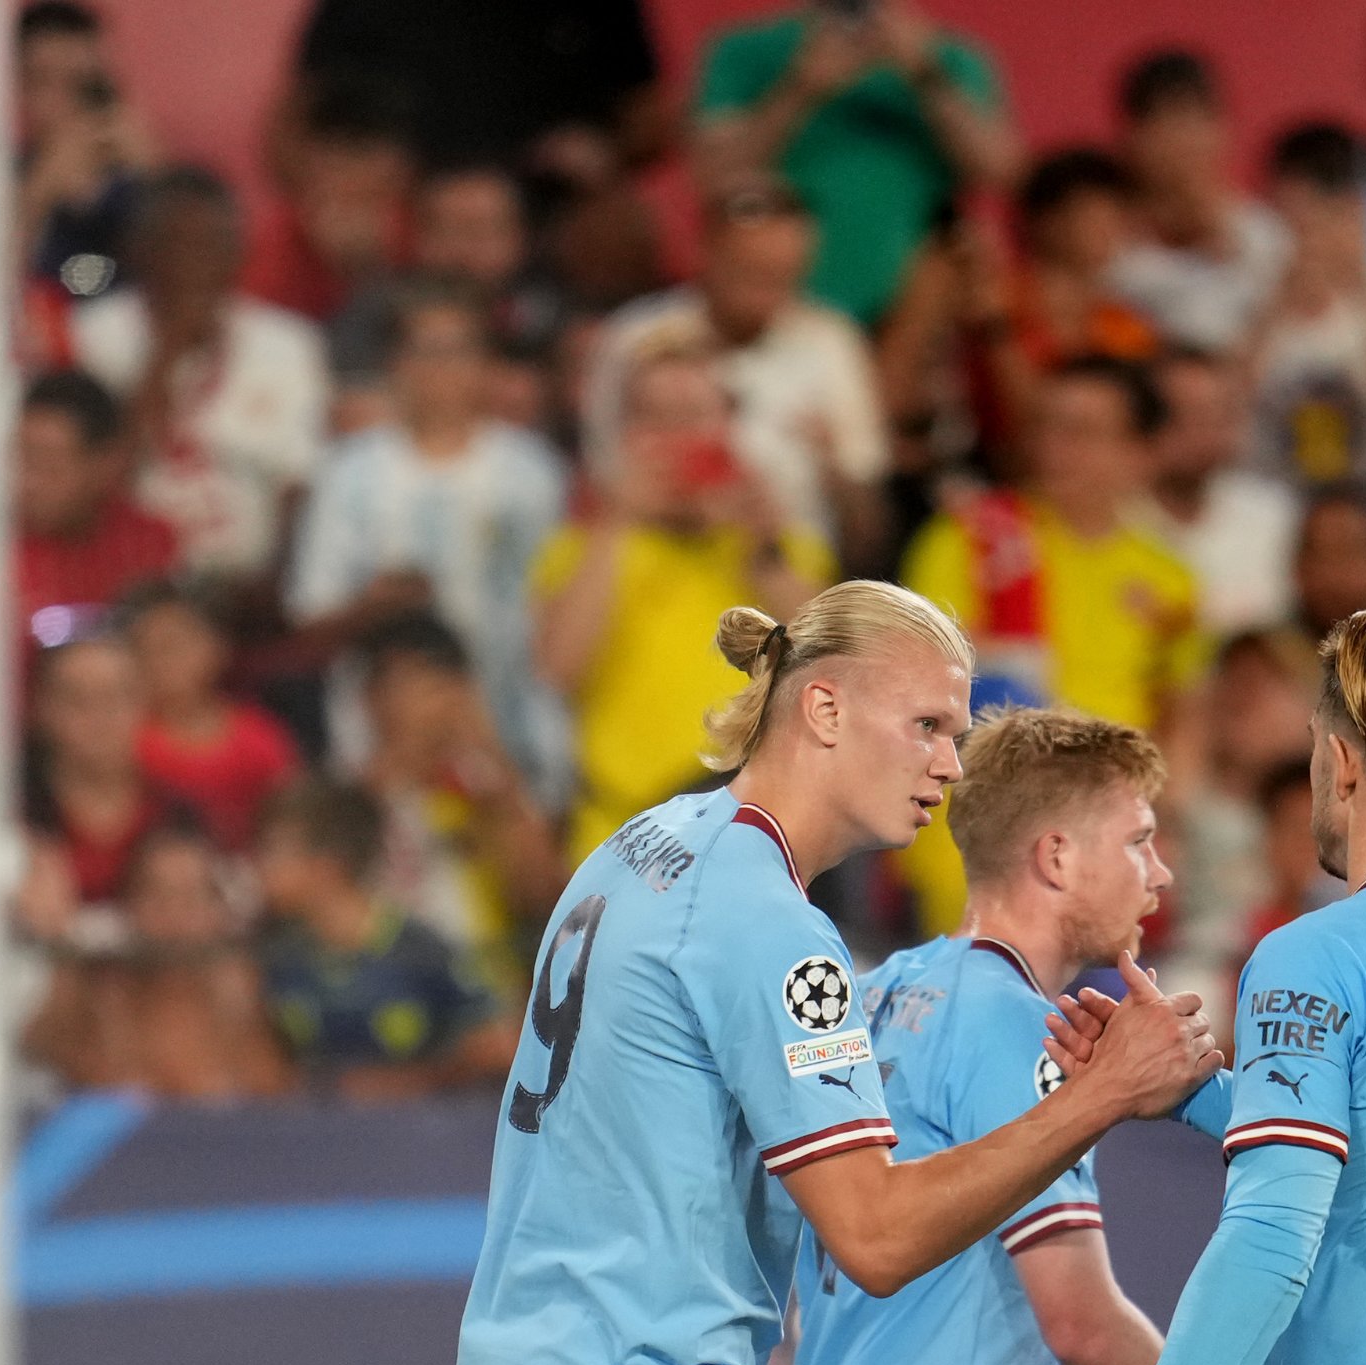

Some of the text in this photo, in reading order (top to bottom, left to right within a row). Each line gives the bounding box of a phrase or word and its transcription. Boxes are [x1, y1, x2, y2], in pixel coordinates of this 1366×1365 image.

[508, 894, 606, 1134] 9
[1251, 990, 1350, 1035] NEXEN
[788, 1038, 868, 1066] FOUNDATION
[1257, 1021, 1328, 1053] TIRE
